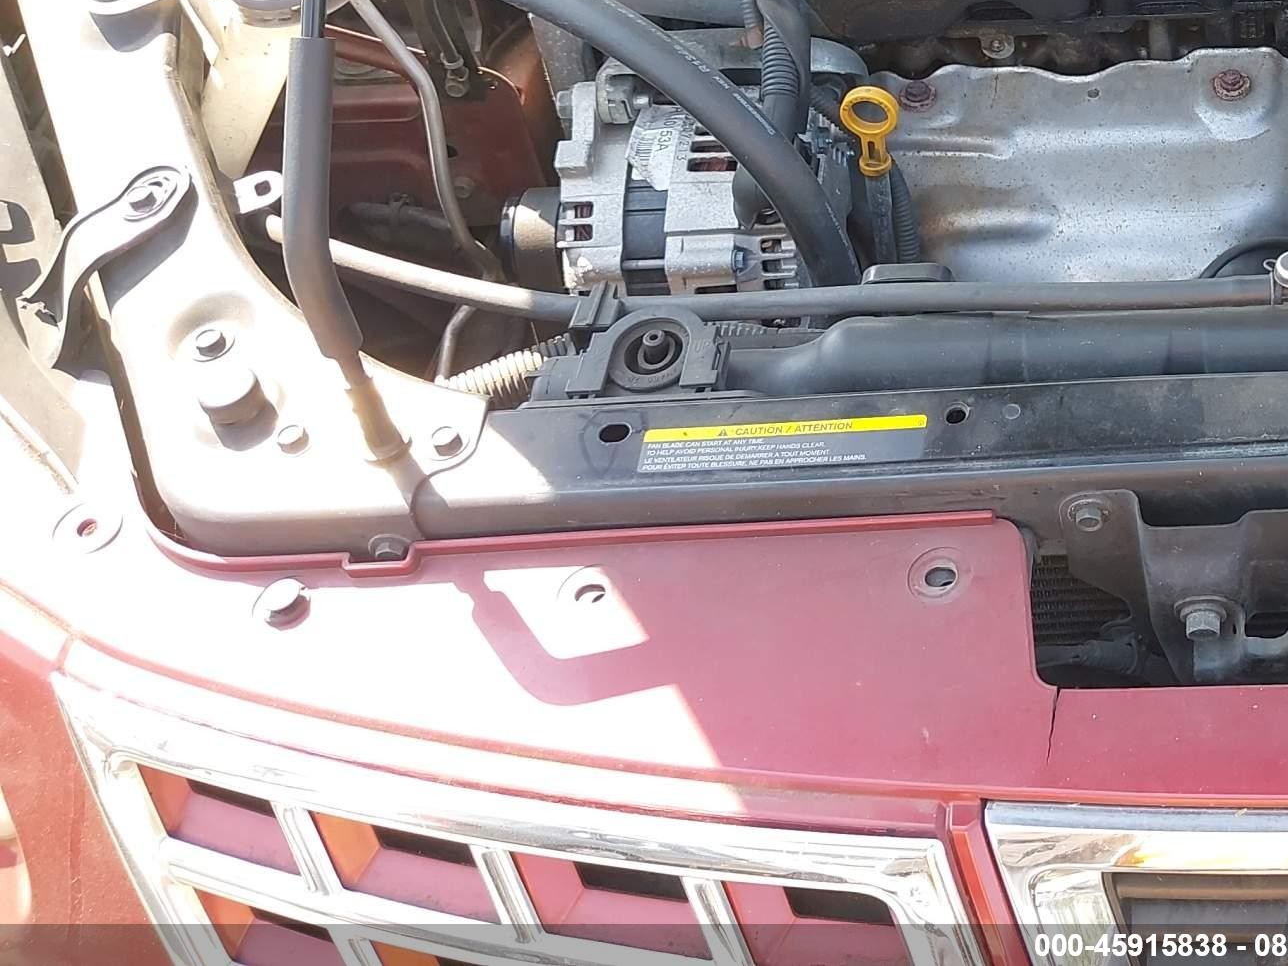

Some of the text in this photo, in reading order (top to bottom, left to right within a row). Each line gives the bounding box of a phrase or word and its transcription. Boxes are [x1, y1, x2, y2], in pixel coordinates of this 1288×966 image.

[735, 426, 782, 435] CAUTION
[794, 422, 852, 432] ATTENTION
[785, 455, 827, 463] APPROCHER
